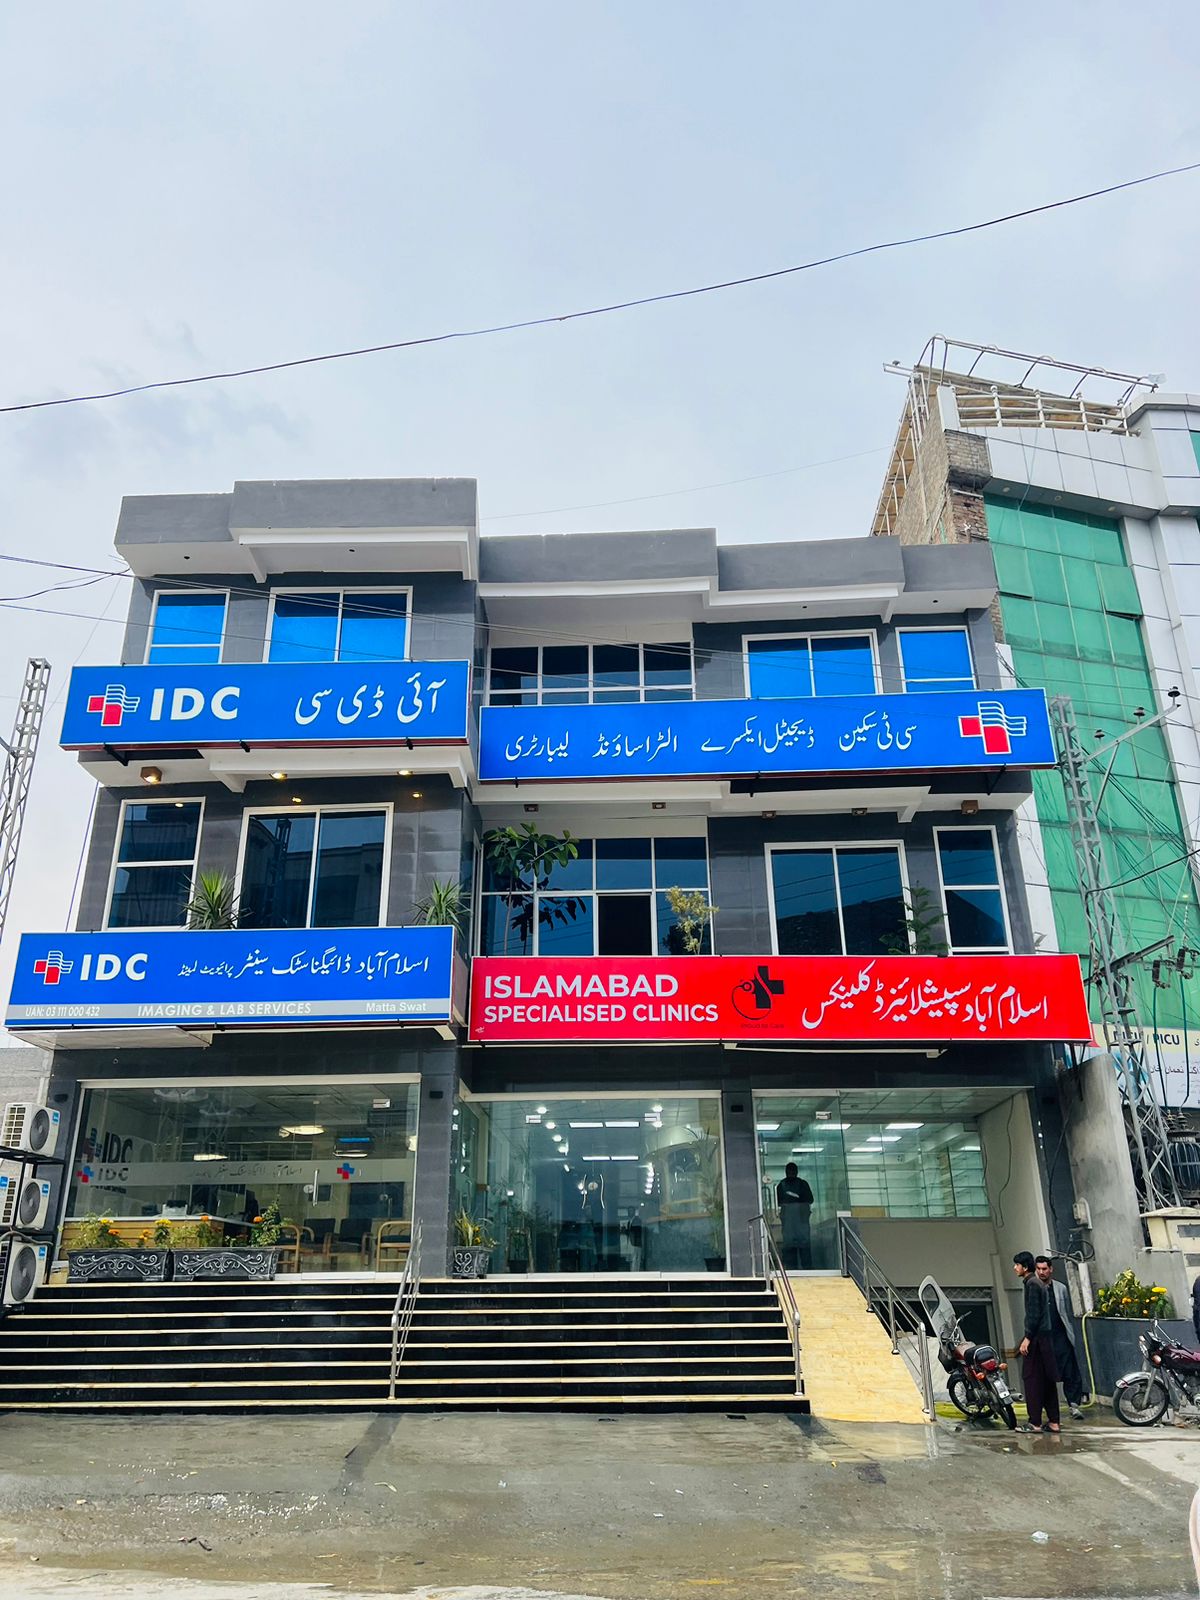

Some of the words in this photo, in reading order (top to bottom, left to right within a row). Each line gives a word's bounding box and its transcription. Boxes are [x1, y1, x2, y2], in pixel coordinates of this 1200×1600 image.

[150, 686, 241, 721] IDC
[294, 688, 332, 725] سی
[336, 684, 384, 725] ڈی
[396, 672, 447, 723] آئی
[504, 730, 570, 763] لیبارٹری
[700, 715, 762, 755] ایکسرے
[838, 710, 877, 752] سکین
[876, 712, 895, 751] ٹی
[895, 724, 918, 751] سی
[80, 953, 148, 981] IDC
[234, 949, 269, 979] سینٹر
[355, 950, 388, 981] آباد
[383, 952, 429, 978] اسلام
[484, 974, 679, 999] ISLAMABAD
[25, 1007, 44, 1017] UAN:
[45, 1007, 56, 1017] 03
[57, 1007, 67, 1017] 111
[68, 1006, 84, 1017] 000
[85, 1006, 100, 1017] 432
[137, 1004, 202, 1017] IMAGING
[206, 1005, 215, 1015] &
[220, 1004, 244, 1015] LAB
[249, 1002, 312, 1015] SERVICES
[366, 1002, 396, 1012] Matta
[399, 1002, 427, 1012] Swat
[483, 1004, 626, 1024] SPECIALISED
[632, 1003, 719, 1023] CLINICS
[962, 983, 997, 1032] آباد
[999, 986, 1048, 1029] اسلام
[98, 1167, 129, 1182] IDC
